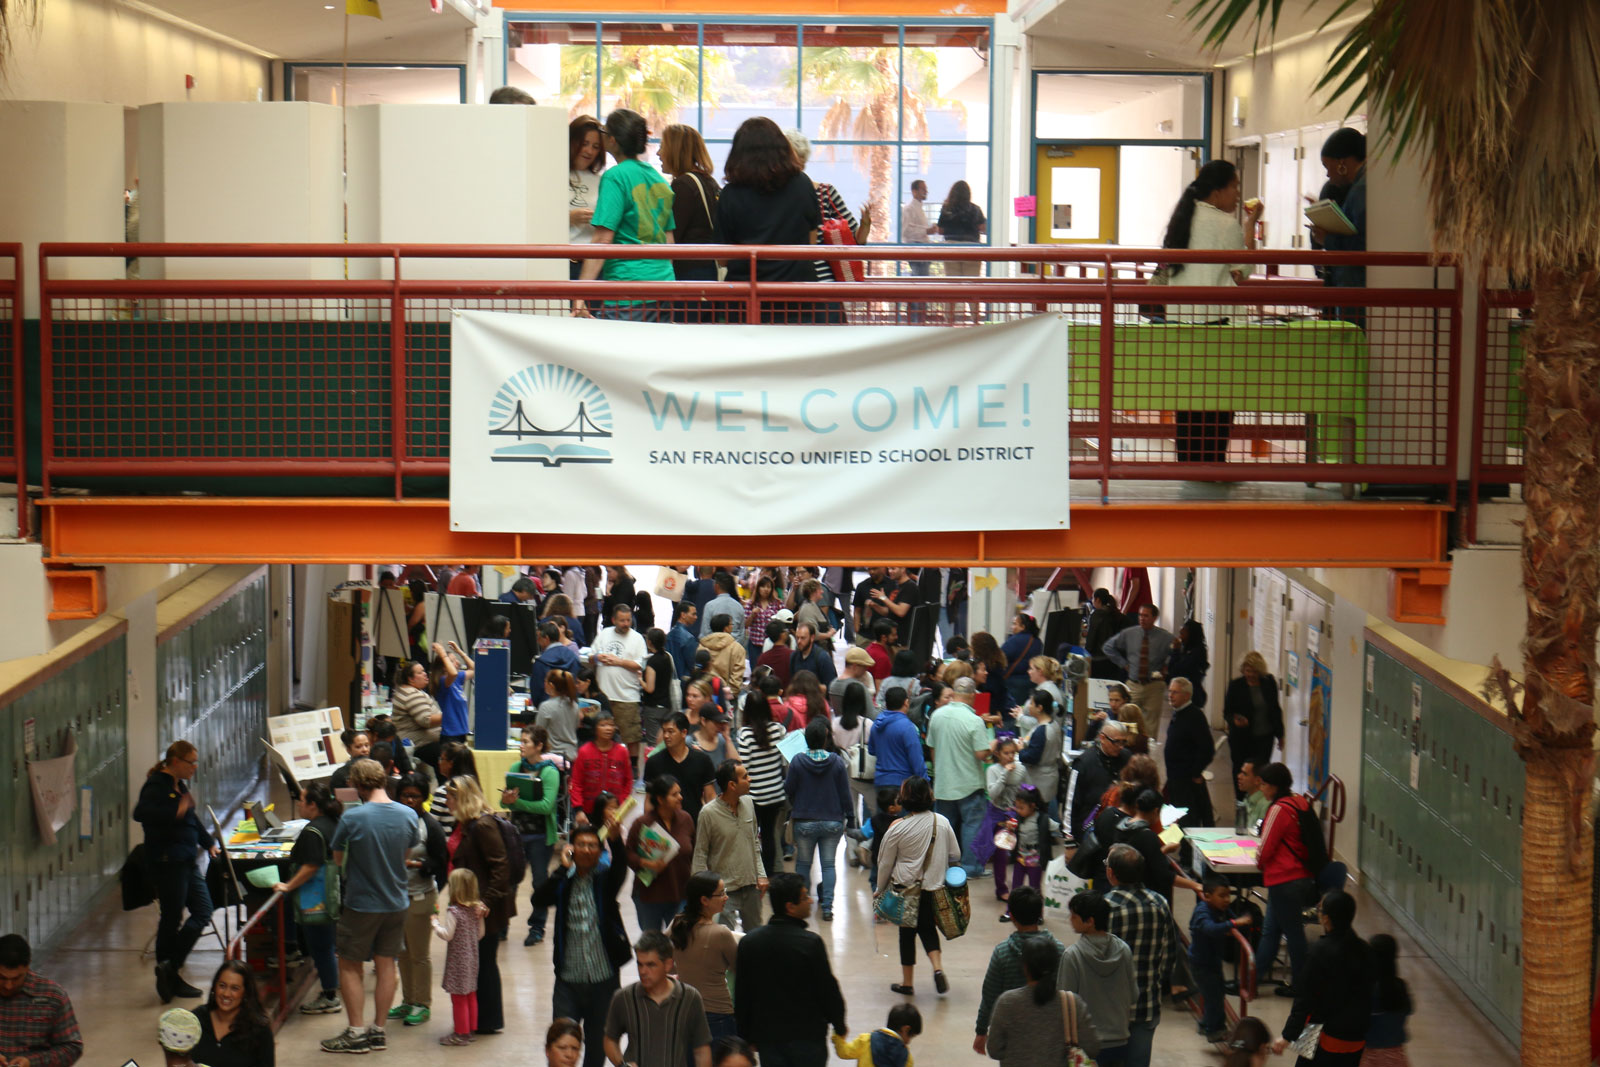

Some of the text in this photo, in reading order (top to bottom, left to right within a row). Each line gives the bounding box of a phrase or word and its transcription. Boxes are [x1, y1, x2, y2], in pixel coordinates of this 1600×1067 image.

[642, 383, 1032, 433] WELCOME!
[648, 446, 1034, 465] SAN FRANCISCO UNIFIED SCHOOL DISTRICT
